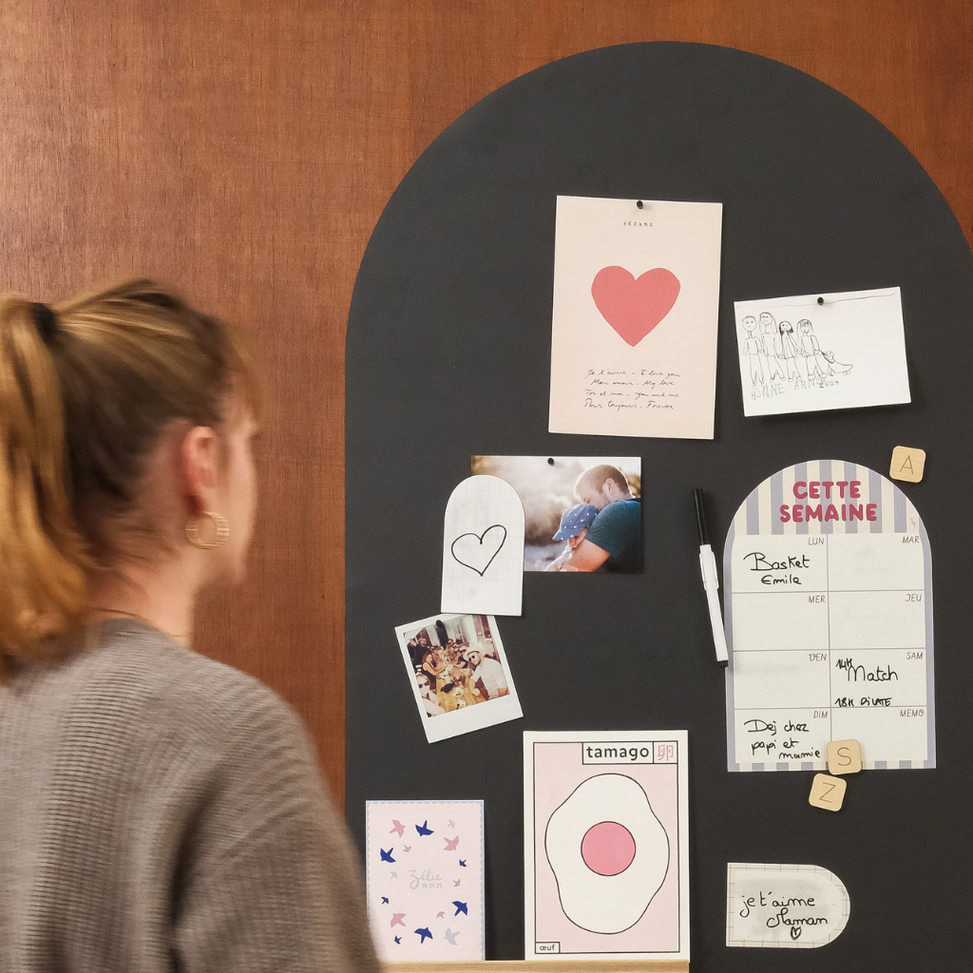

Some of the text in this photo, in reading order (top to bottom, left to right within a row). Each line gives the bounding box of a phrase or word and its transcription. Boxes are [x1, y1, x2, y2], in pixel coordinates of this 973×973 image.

[899, 455, 914, 475] A
[792, 480, 862, 500] CETTE
[779, 503, 878, 523] SEMAINE
[807, 537, 825, 546] LUN
[902, 535, 919, 544] MAR
[743, 551, 811, 572] Basket
[760, 574, 802, 586] Emile
[807, 595, 826, 604] MER
[904, 593, 922, 603] JEU
[808, 653, 827, 662] VEN
[906, 651, 924, 660] SAM
[846, 664, 899, 682] Match
[813, 710, 829, 719] DIM
[899, 708, 925, 718] MEMO
[783, 720, 810, 733] chez
[750, 737, 800, 756] papi et
[586, 746, 649, 761] tamago
[778, 747, 821, 760] mamie
[836, 747, 852, 767] S
[818, 781, 837, 804] Z
[407, 868, 443, 890] Zélie
[739, 895, 756, 918] je
[539, 943, 555, 951] œuf
